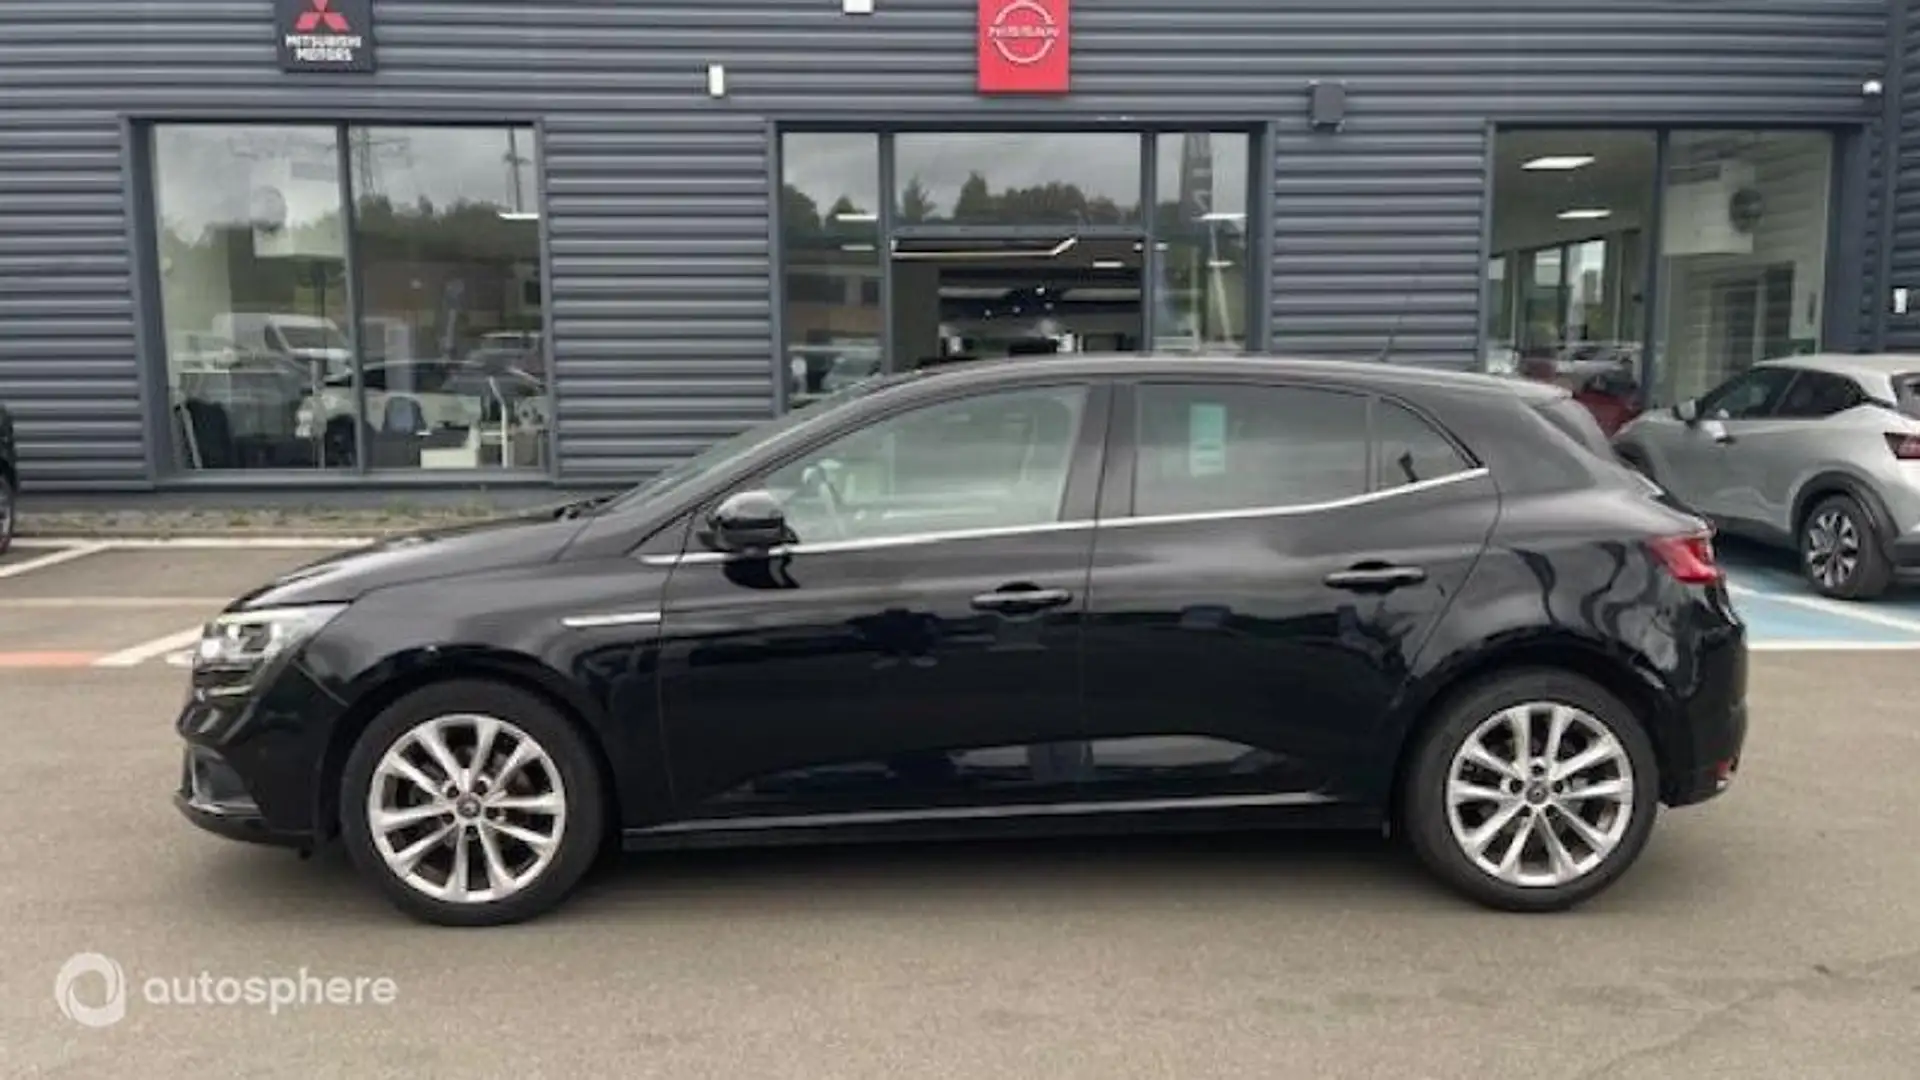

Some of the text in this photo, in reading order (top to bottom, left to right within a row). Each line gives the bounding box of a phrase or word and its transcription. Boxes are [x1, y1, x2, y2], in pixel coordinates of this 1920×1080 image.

[988, 25, 1060, 37] NISSAN
[285, 34, 362, 48] MITSUBISHI
[296, 47, 353, 61] MOTORS
